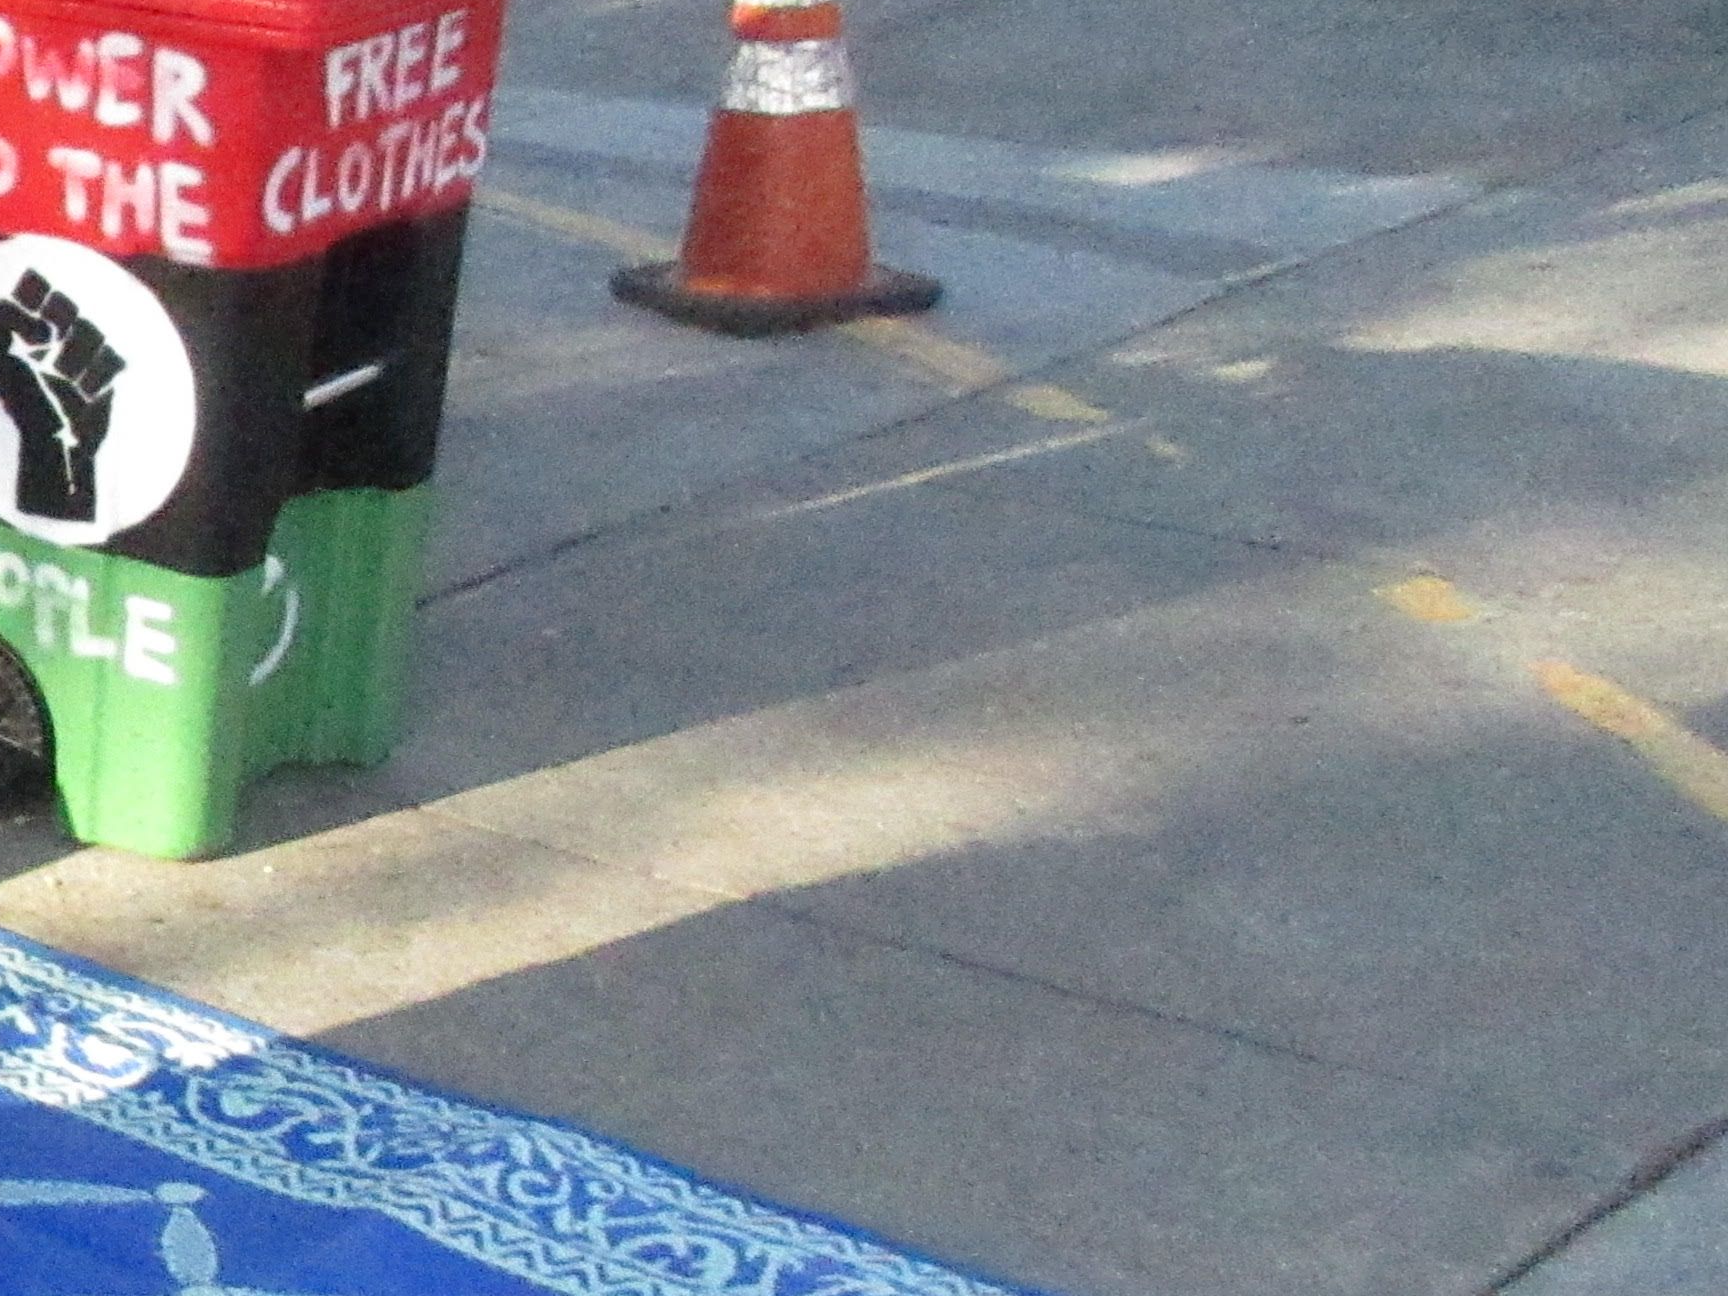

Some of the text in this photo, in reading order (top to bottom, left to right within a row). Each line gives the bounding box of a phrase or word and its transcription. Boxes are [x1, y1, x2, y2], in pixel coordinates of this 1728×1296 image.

[325, 8, 469, 130] FREE
[47, 145, 215, 267] THE
[262, 99, 487, 237] CLOTHES
